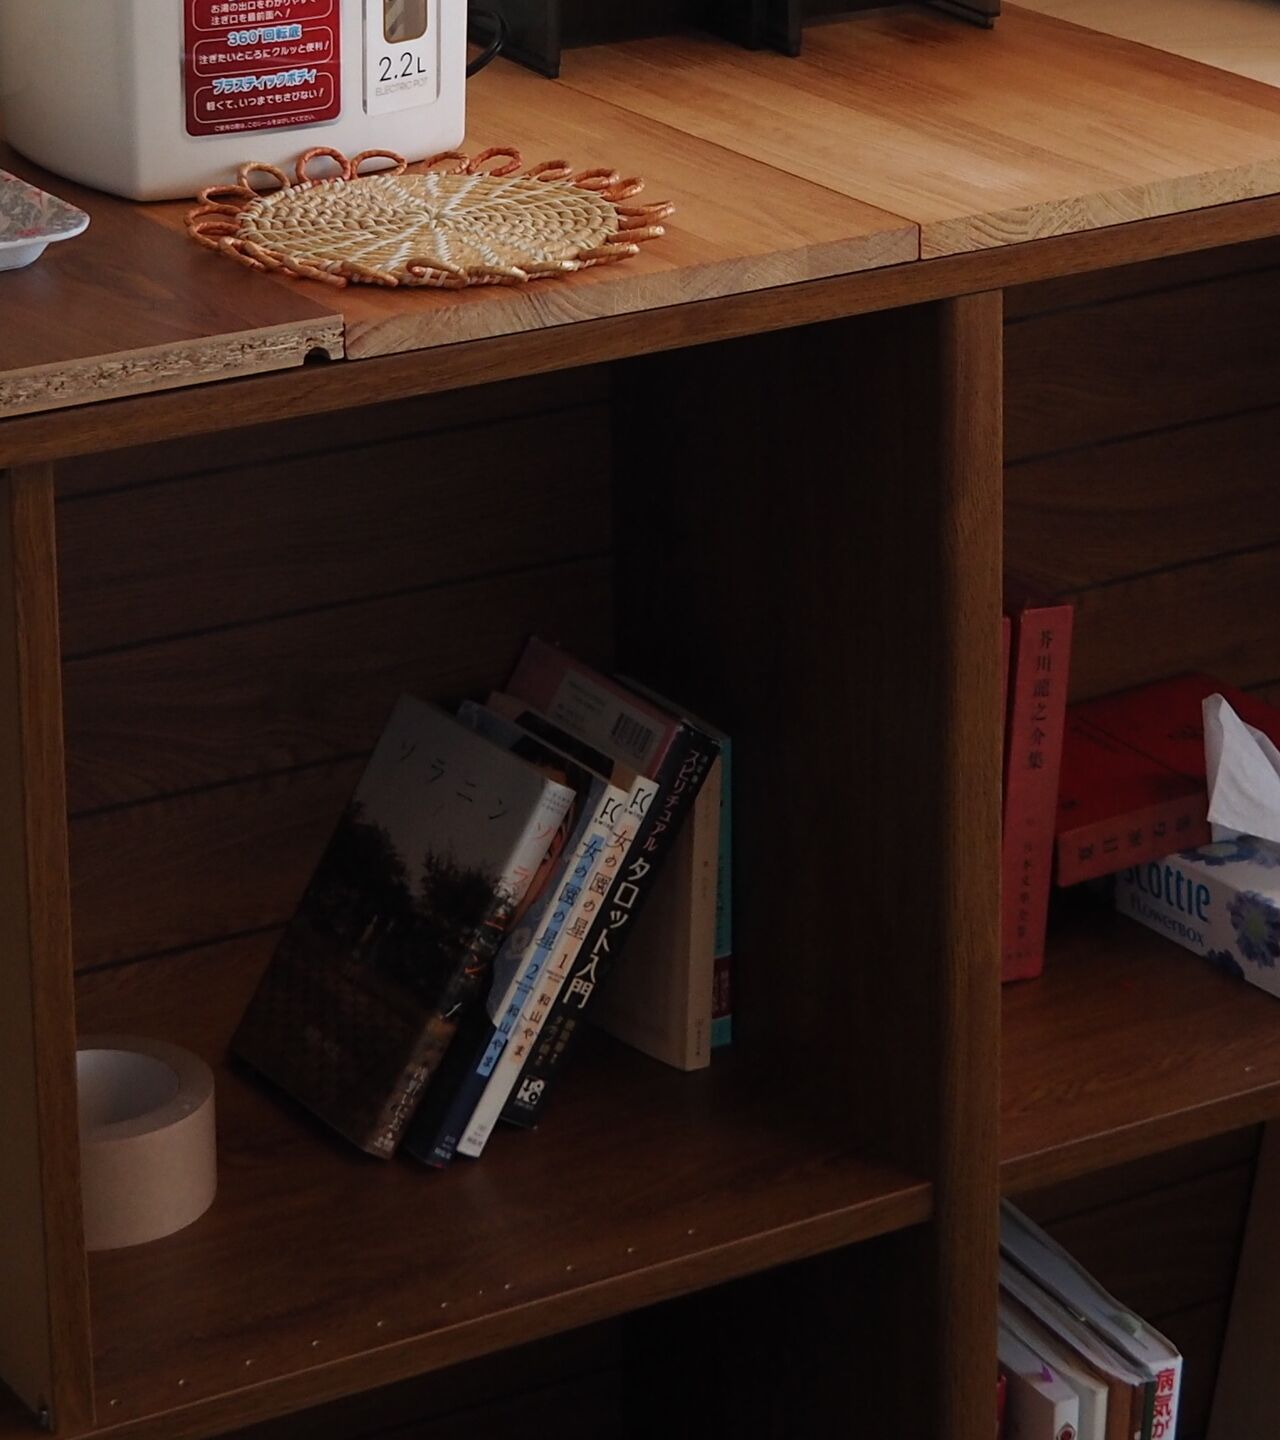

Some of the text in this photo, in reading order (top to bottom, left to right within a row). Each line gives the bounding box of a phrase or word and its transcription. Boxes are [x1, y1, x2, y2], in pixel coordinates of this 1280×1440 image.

[212, 68, 317, 96] プラスティックボディ
[399, 743, 509, 821] ソラニン
[535, 839, 602, 951] 女の園の星
[558, 829, 632, 970] 女の園の星 1
[562, 749, 700, 1010] スピリチュアル タロット入門
[526, 963, 539, 981] 2
[482, 1005, 520, 1069] 和山やま
[515, 993, 551, 1058] 和山やま
[1151, 1368, 1175, 1439] 病気が
